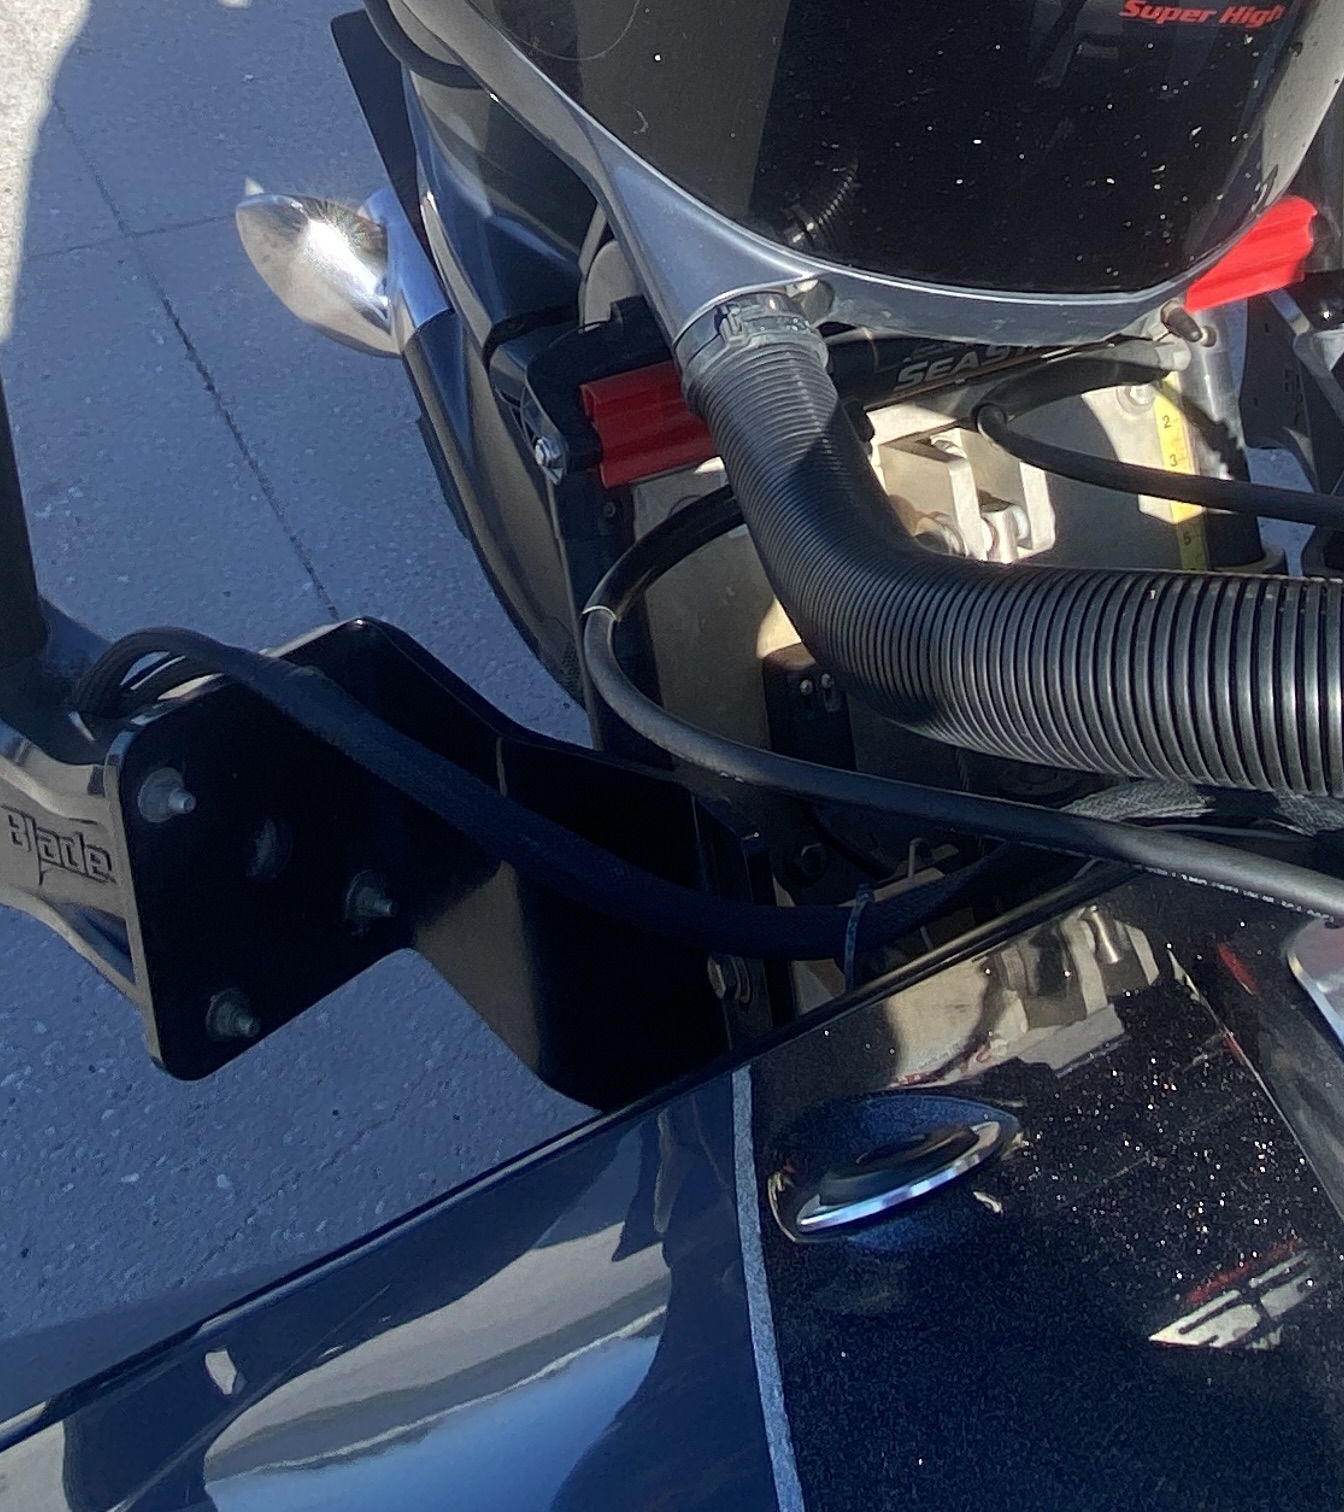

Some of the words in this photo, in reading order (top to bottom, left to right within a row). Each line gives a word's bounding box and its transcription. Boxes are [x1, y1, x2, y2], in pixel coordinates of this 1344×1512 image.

[1119, 0, 1217, 25] Super
[1162, 414, 1171, 429] 2
[1169, 453, 1179, 468] 3
[1182, 529, 1193, 546] 5
[0, 803, 116, 886] Blade
